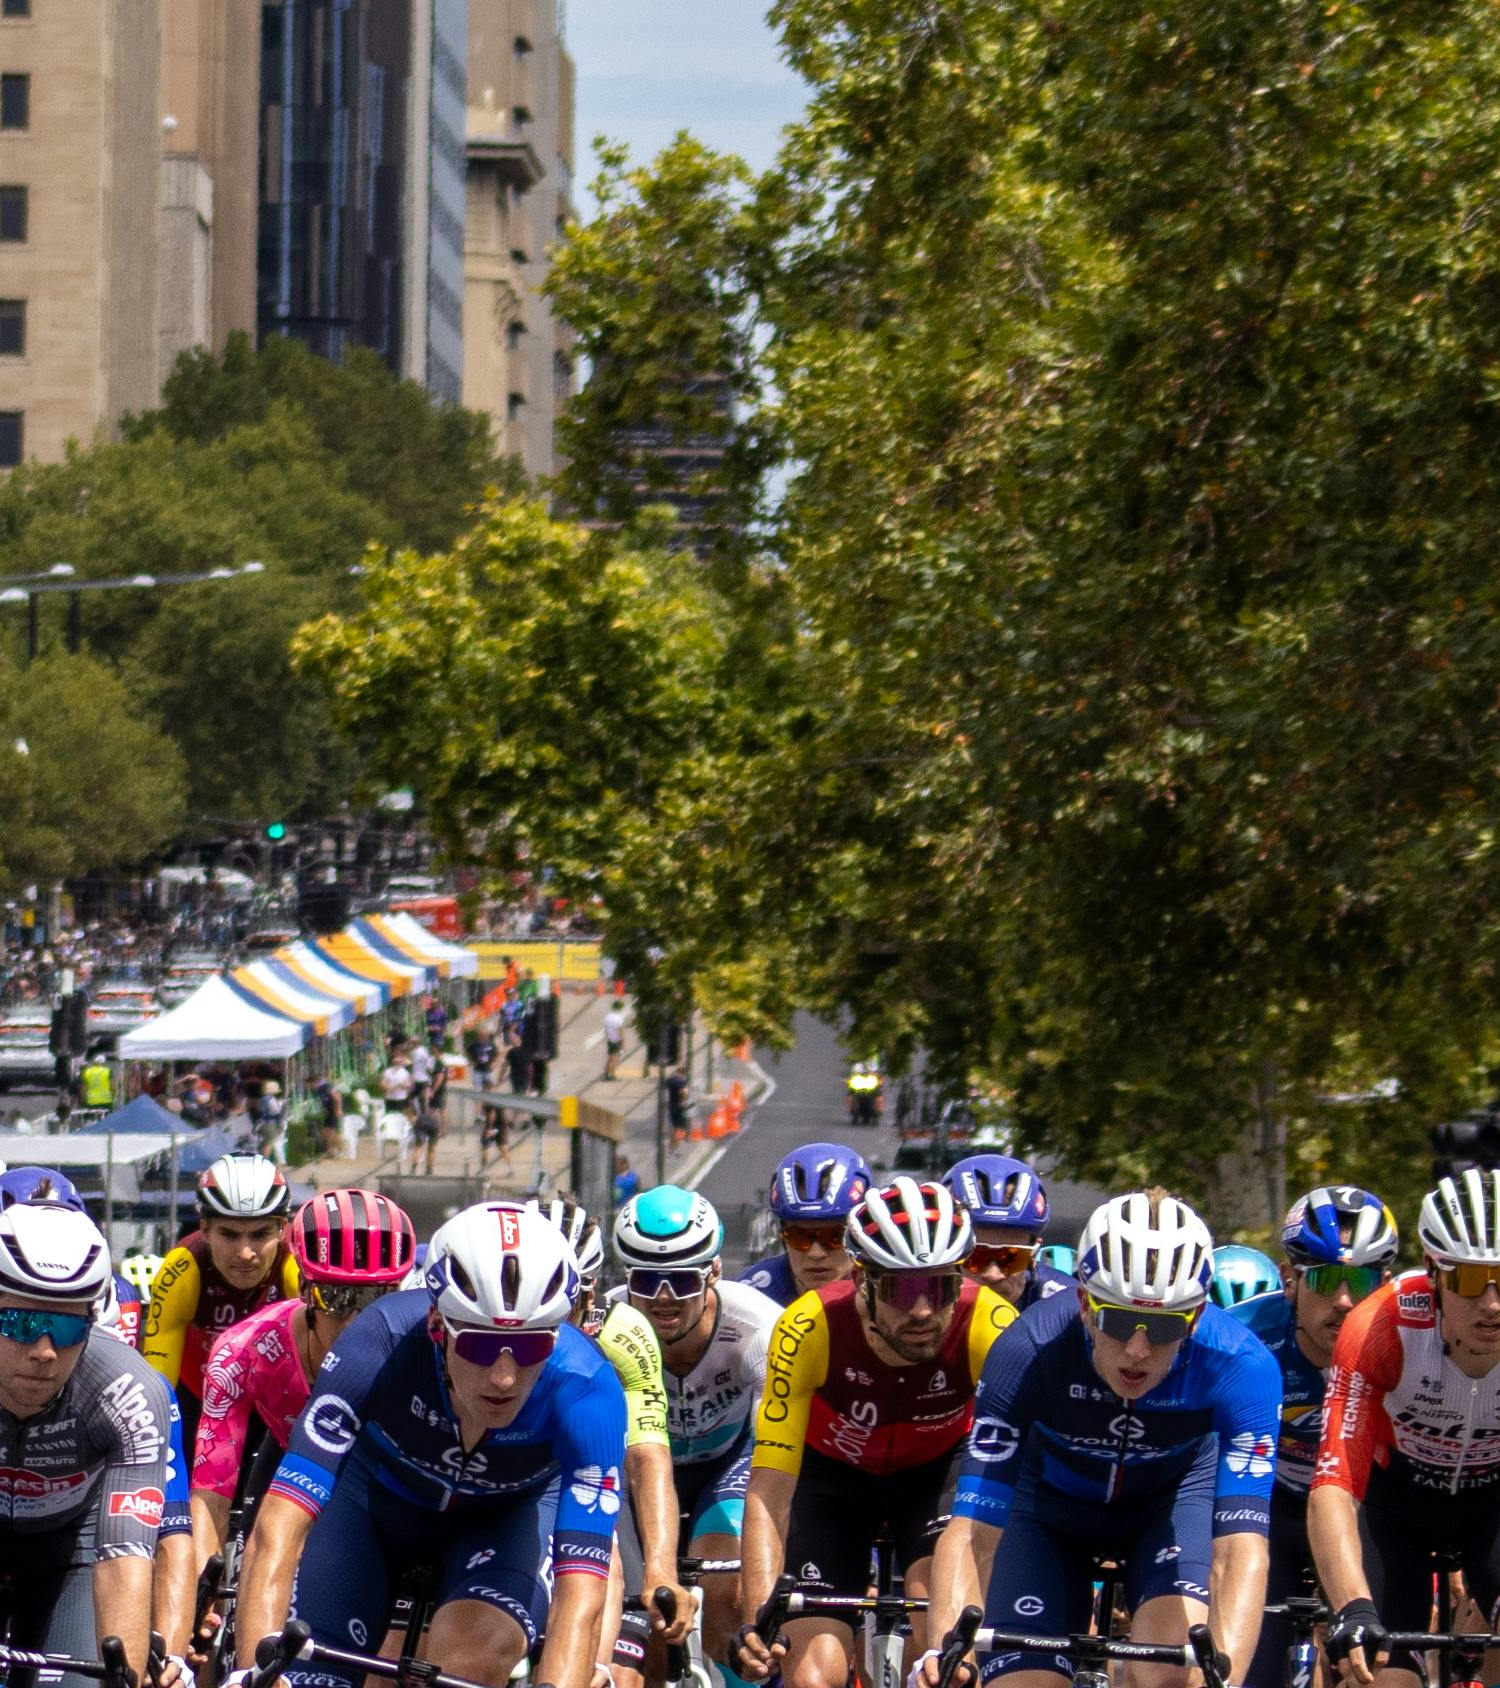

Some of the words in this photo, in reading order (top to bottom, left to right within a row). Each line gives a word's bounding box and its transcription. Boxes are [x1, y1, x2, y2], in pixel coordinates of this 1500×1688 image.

[144, 1257, 190, 1338] Cofidis
[1399, 1293, 1433, 1310] Inter
[764, 1310, 817, 1423] Cofidis
[1340, 1370, 1364, 1440] TECHNORD
[1414, 1392, 1445, 1406] uvex
[43, 1417, 77, 1434] ZWIFT
[102, 1372, 166, 1465] Alpecin
[25, 1439, 78, 1452] CANYON
[120, 1495, 165, 1515] Alpec
